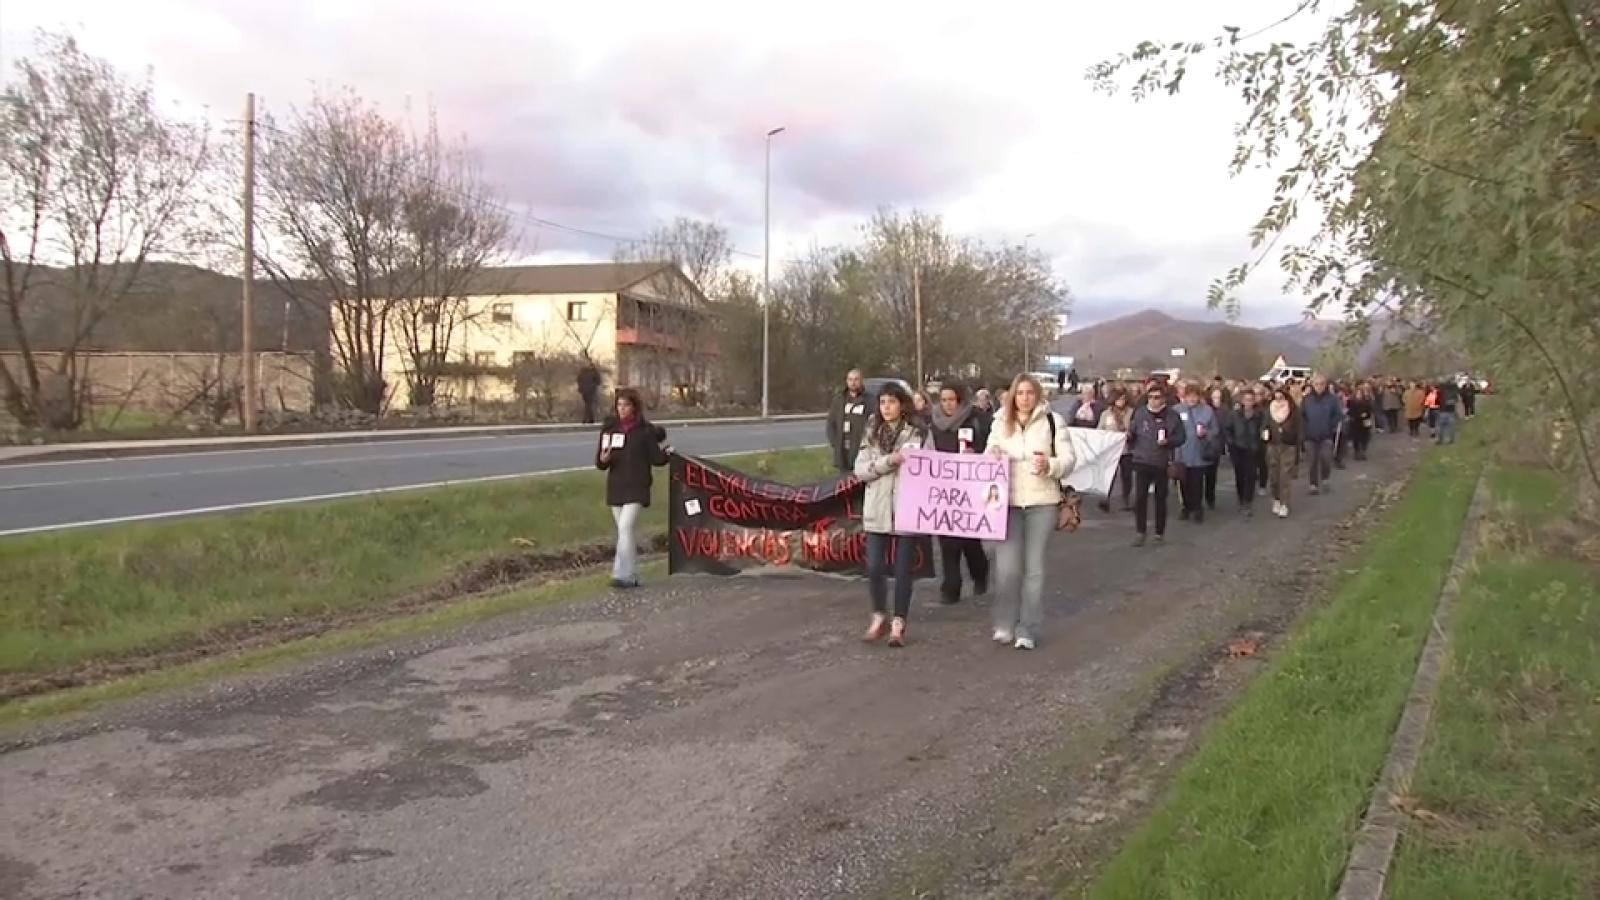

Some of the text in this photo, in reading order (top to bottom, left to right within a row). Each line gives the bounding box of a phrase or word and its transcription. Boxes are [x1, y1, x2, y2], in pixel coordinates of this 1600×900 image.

[685, 462, 716, 489] EL
[908, 454, 1008, 482] JUSTICIA
[706, 494, 806, 522] CONTRA
[928, 486, 972, 509] PARA
[917, 507, 993, 534] MARIA
[676, 527, 793, 565] VIOLENCIAS
